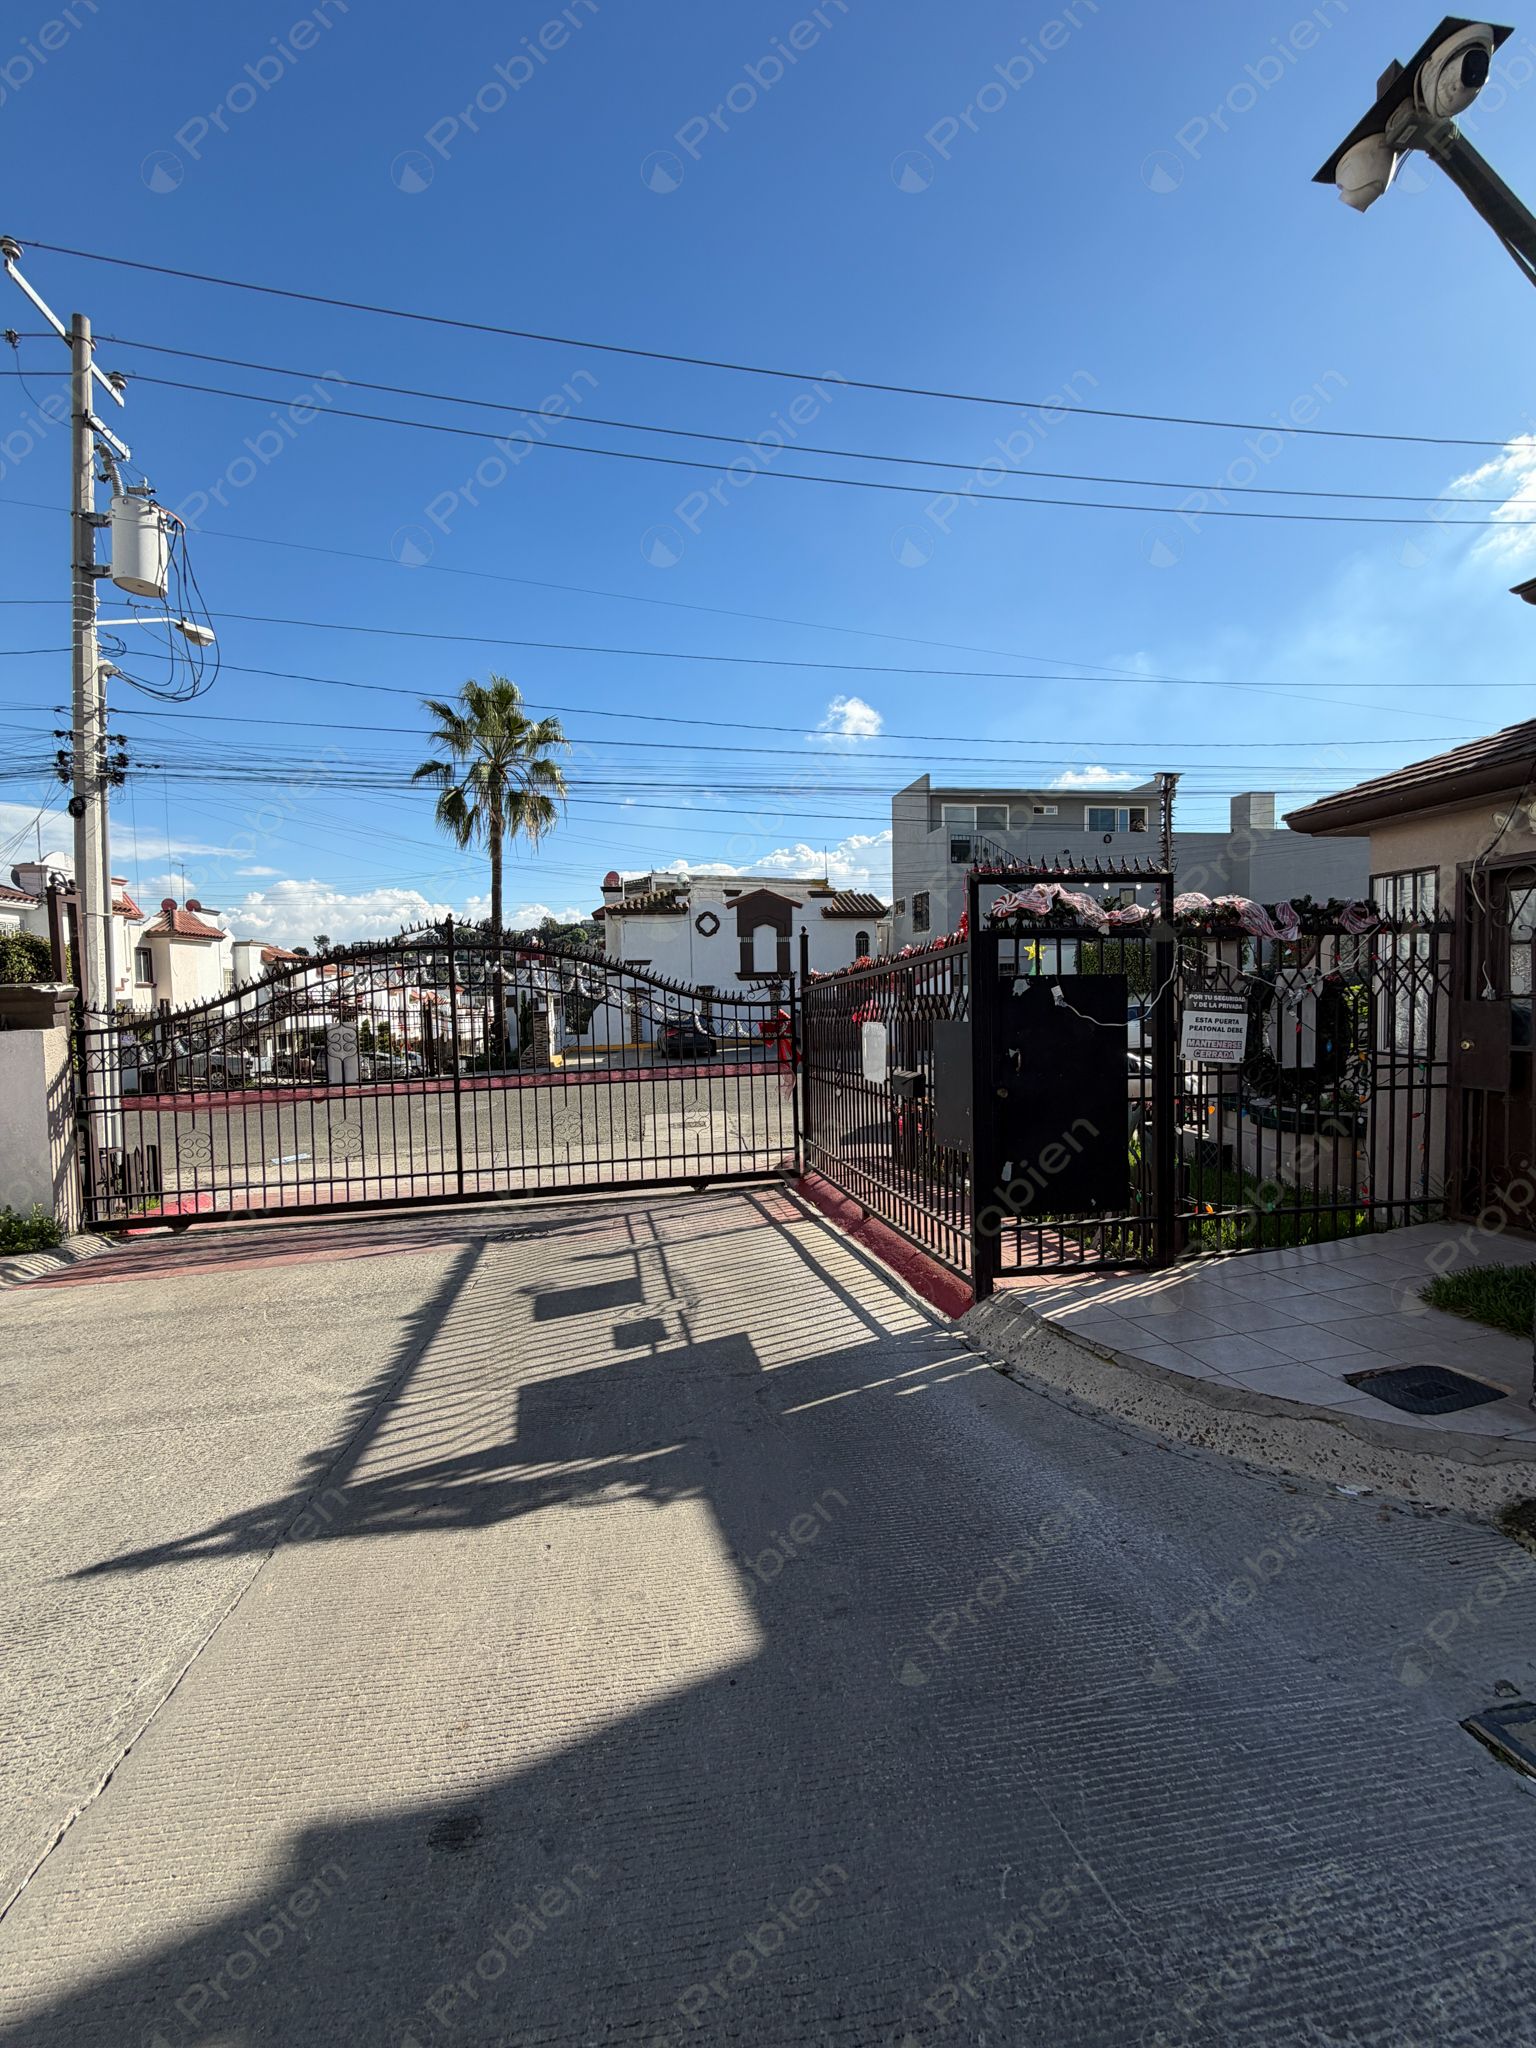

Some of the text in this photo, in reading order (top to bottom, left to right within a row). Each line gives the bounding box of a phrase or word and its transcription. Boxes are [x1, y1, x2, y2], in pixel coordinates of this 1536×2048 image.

[1188, 1025, 1226, 1033] PEATONAL
[1186, 1039, 1242, 1049] MANTENERSE
[1193, 1049, 1234, 1060] CERRADA
